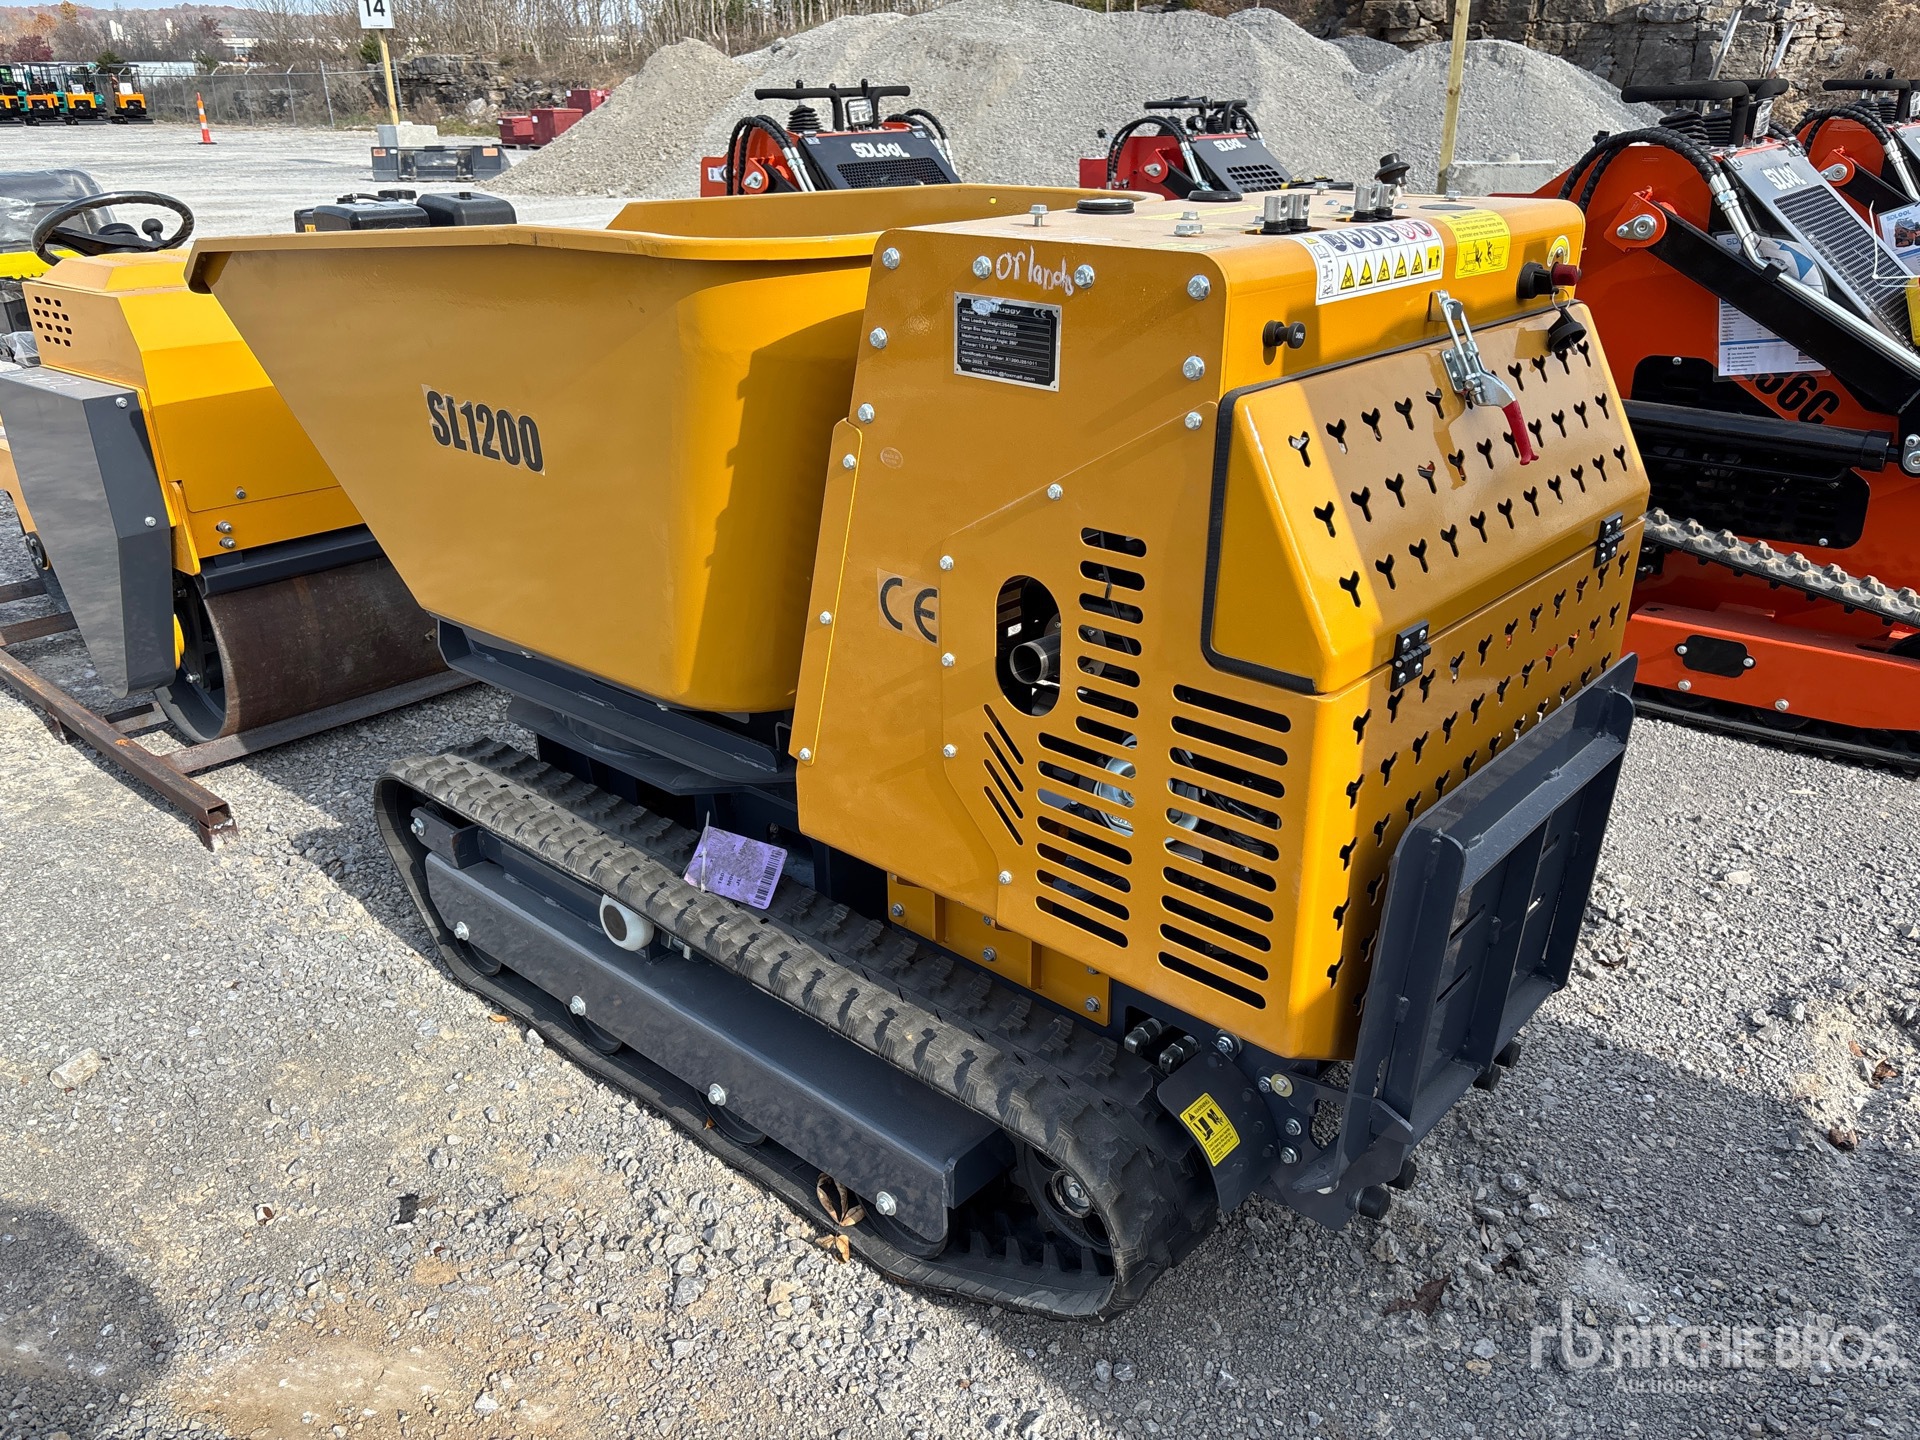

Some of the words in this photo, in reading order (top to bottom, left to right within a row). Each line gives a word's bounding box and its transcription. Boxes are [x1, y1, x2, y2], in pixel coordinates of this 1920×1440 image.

[364, 0, 386, 17] 14
[851, 142, 910, 158] SDLOOL
[427, 391, 543, 472] SL1200
[880, 577, 938, 644] CE
